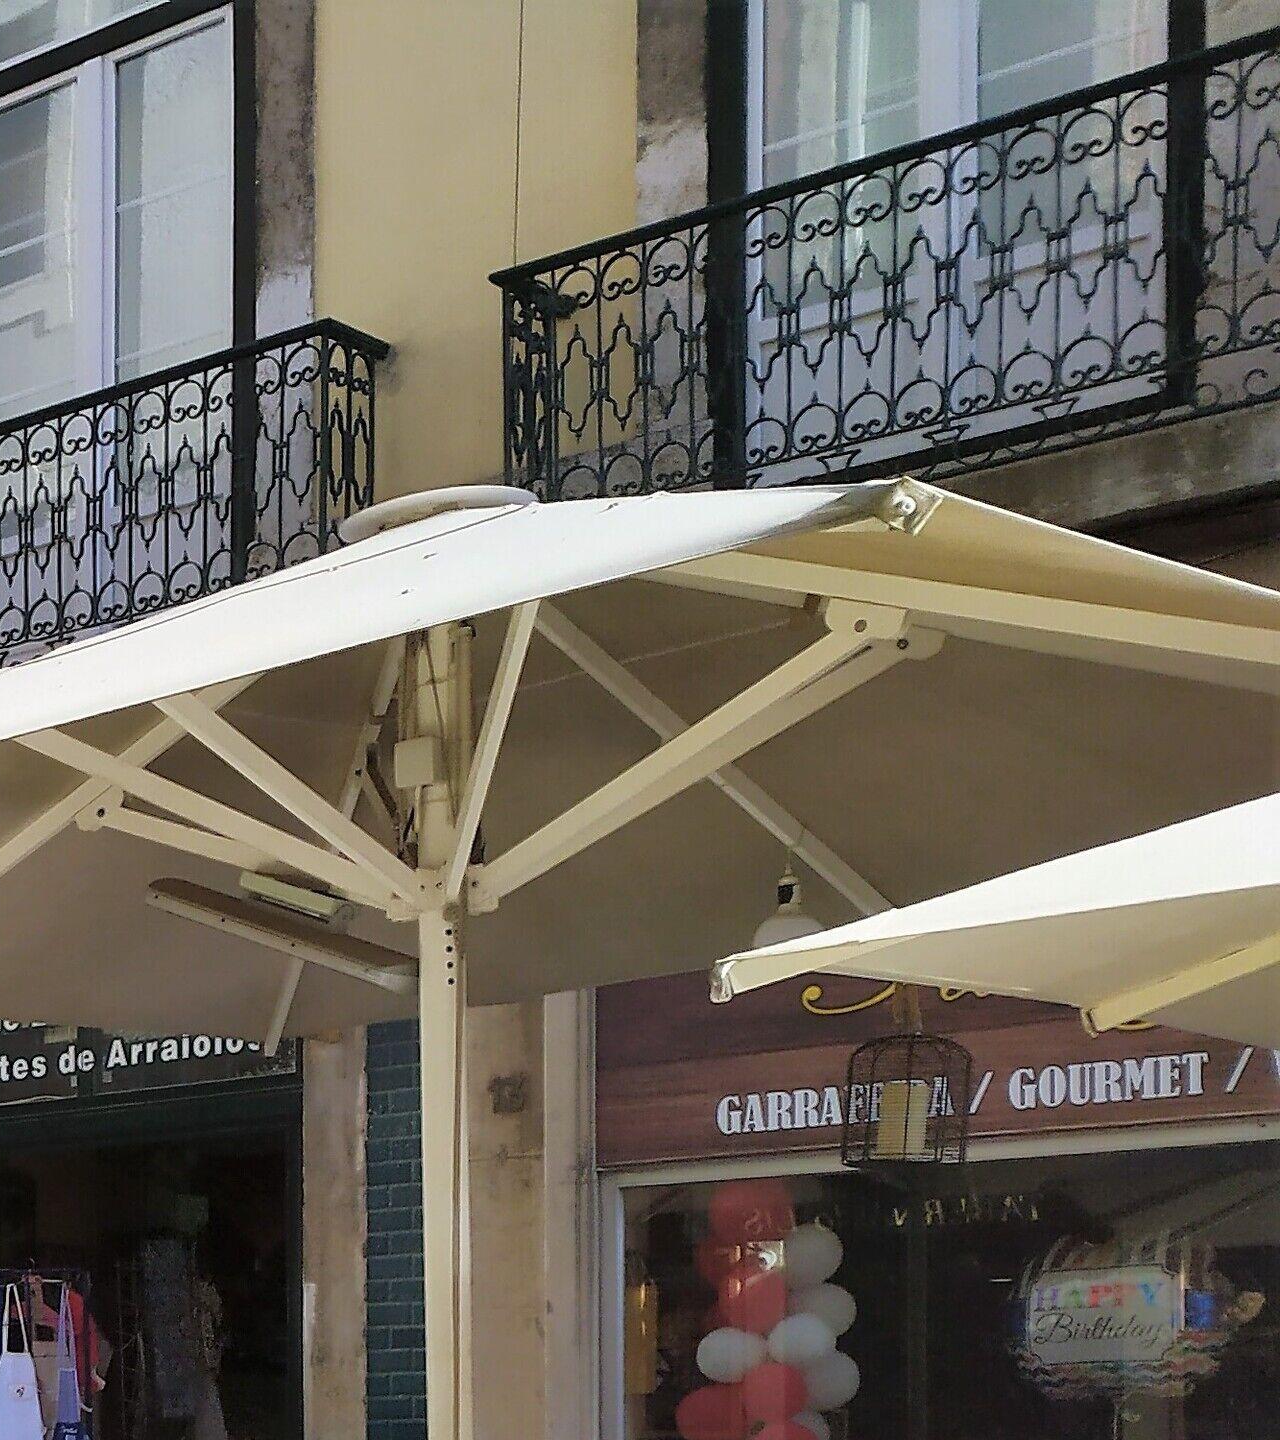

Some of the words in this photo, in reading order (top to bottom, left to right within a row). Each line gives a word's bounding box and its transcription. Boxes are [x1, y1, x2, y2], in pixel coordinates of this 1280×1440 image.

[58, 1045, 96, 1076] de
[1008, 1050, 1210, 1111] GOURMET
[1034, 1312, 1161, 1349] Birthday
